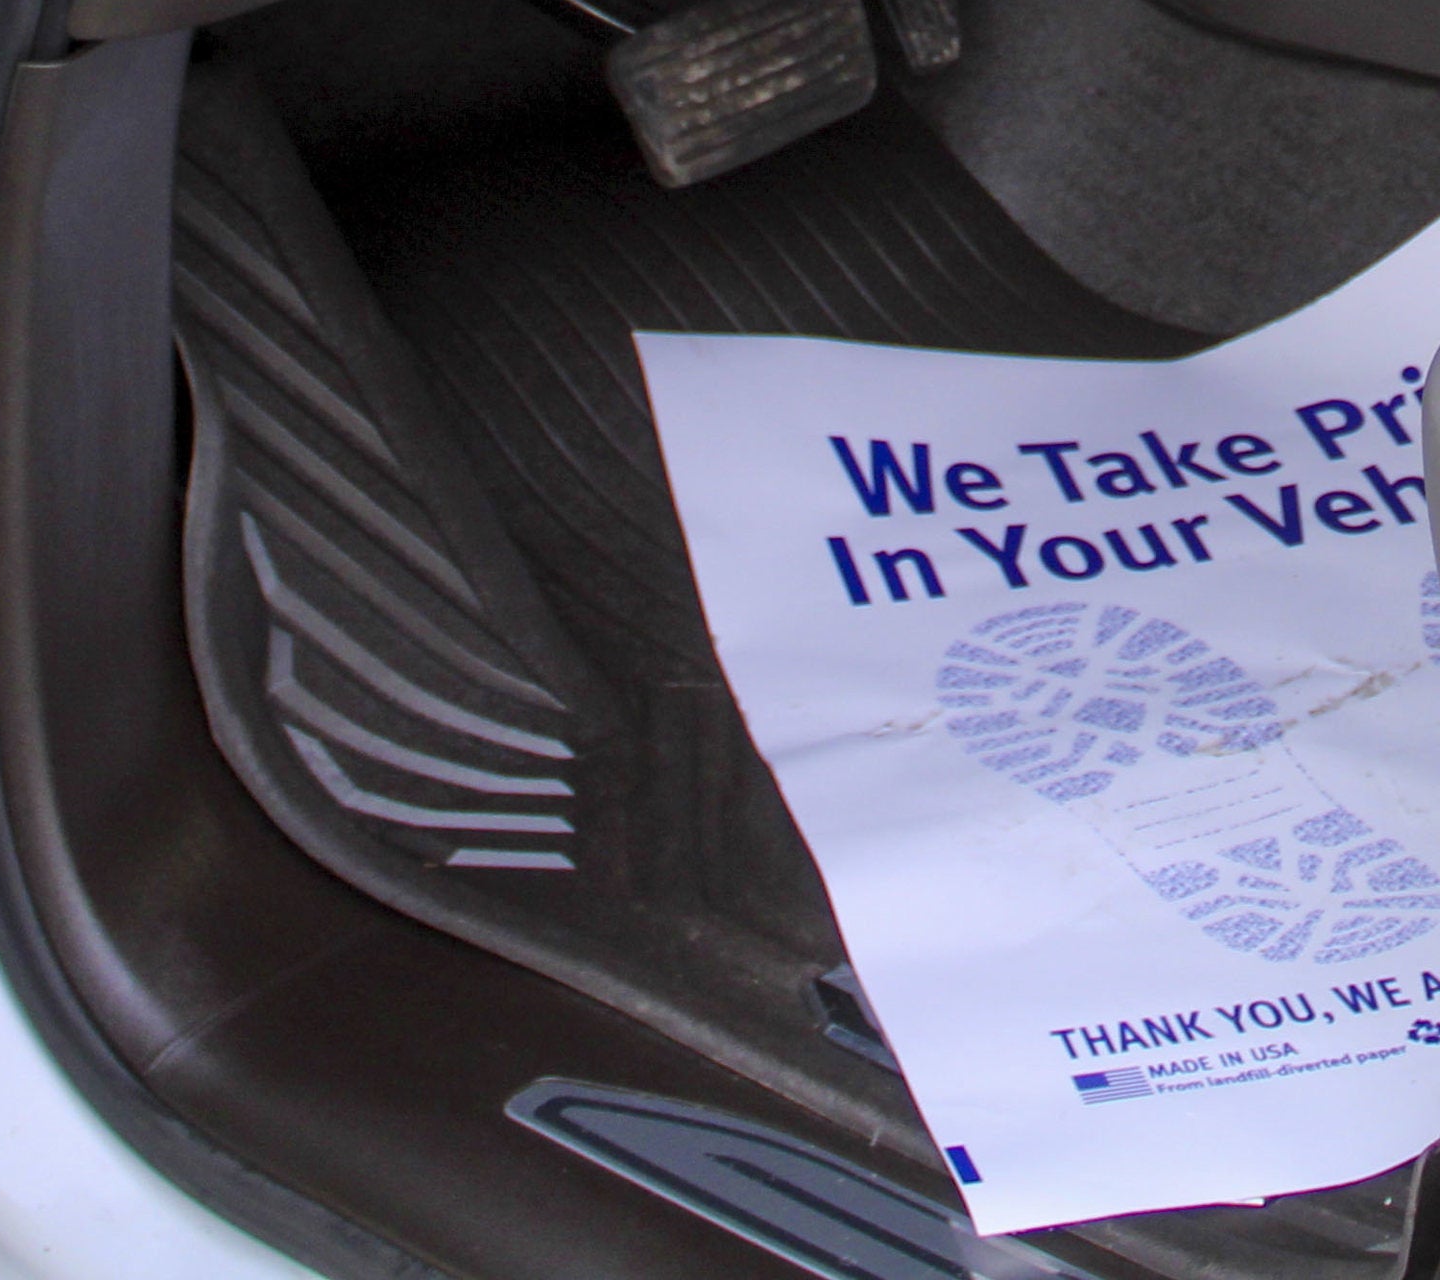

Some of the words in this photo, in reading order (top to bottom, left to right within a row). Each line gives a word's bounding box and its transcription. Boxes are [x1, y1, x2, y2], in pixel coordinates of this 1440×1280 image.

[829, 435, 1009, 517] We
[1018, 431, 1282, 502] Take
[827, 536, 946, 605] In
[955, 514, 1211, 588] Your
[1225, 465, 1426, 547] Veh
[1051, 1008, 1213, 1060] THANK
[1216, 992, 1335, 1033] YOU,
[1335, 978, 1411, 1013] WE
[1148, 1055, 1213, 1079] MADE
[1219, 1050, 1244, 1068] IN
[1250, 1041, 1299, 1062] USA
[1156, 1078, 1205, 1095] From
[1207, 1052, 1353, 1088] landfill-diverted
[1355, 1045, 1409, 1066] paper
